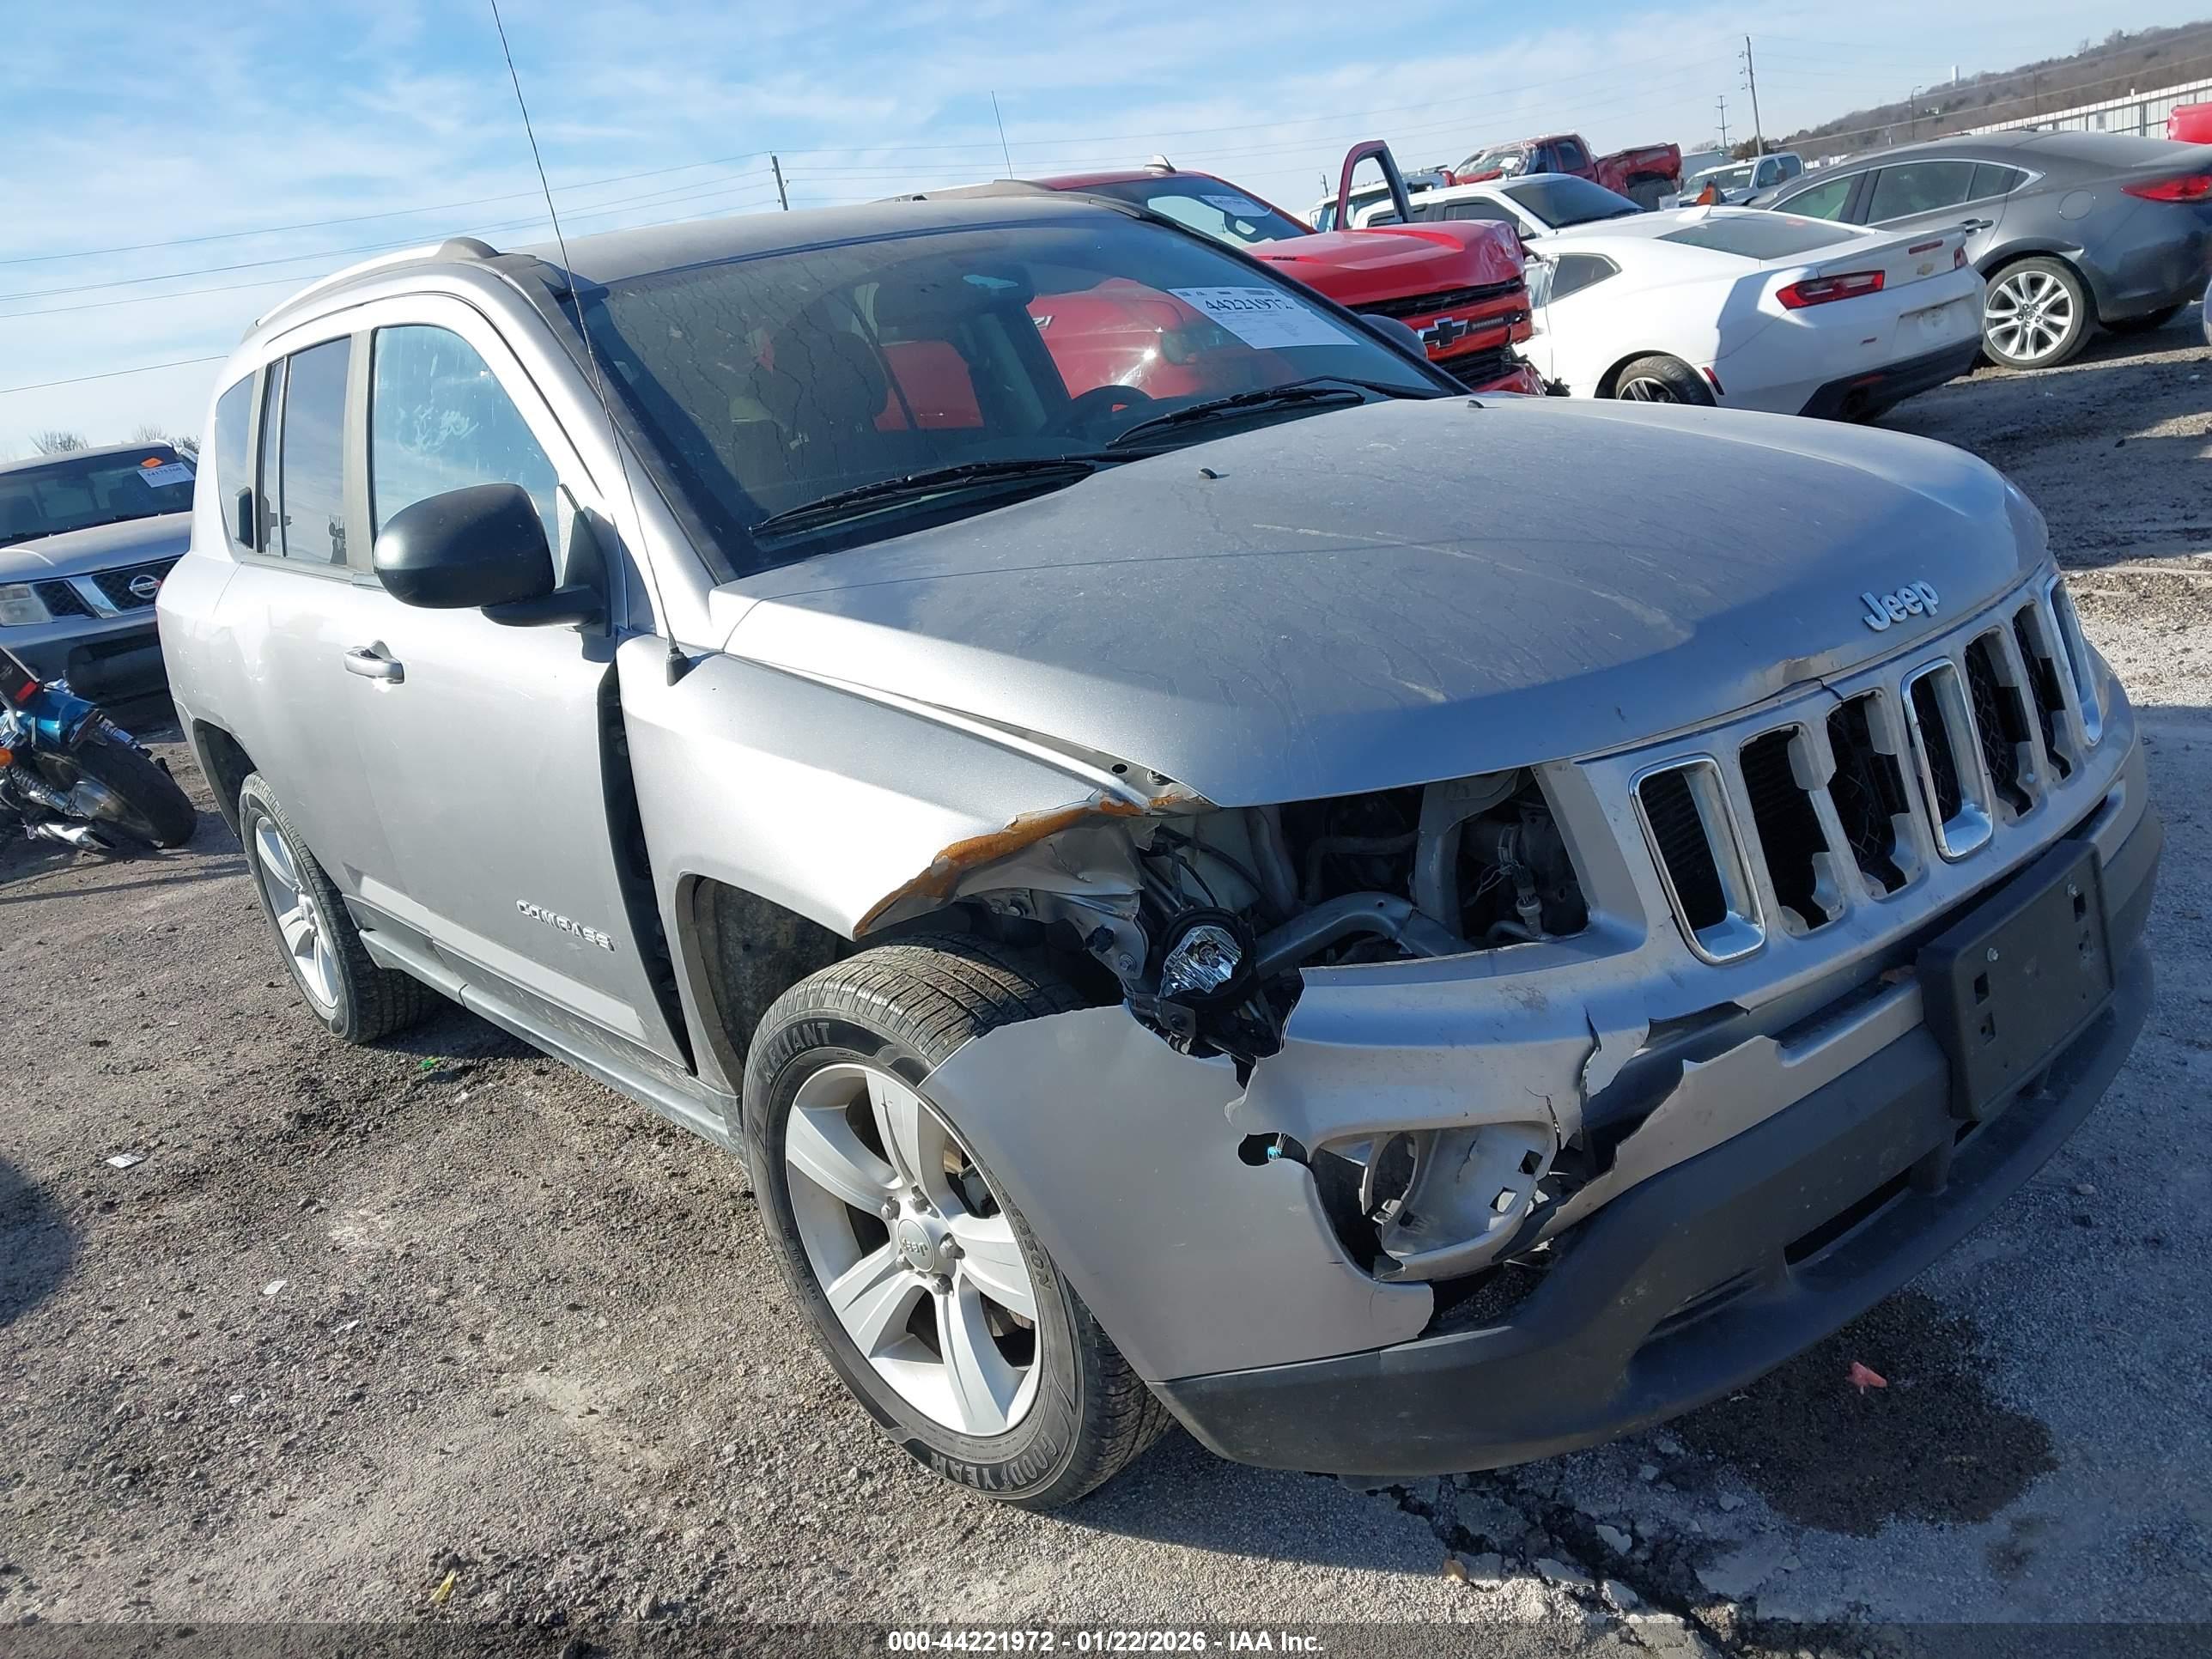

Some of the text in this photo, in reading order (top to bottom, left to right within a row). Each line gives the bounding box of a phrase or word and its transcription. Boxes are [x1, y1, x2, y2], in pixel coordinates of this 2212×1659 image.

[1861, 580, 1939, 631] Jeep
[516, 899, 616, 953] COMPASS
[759, 1022, 830, 1085] RELIANT
